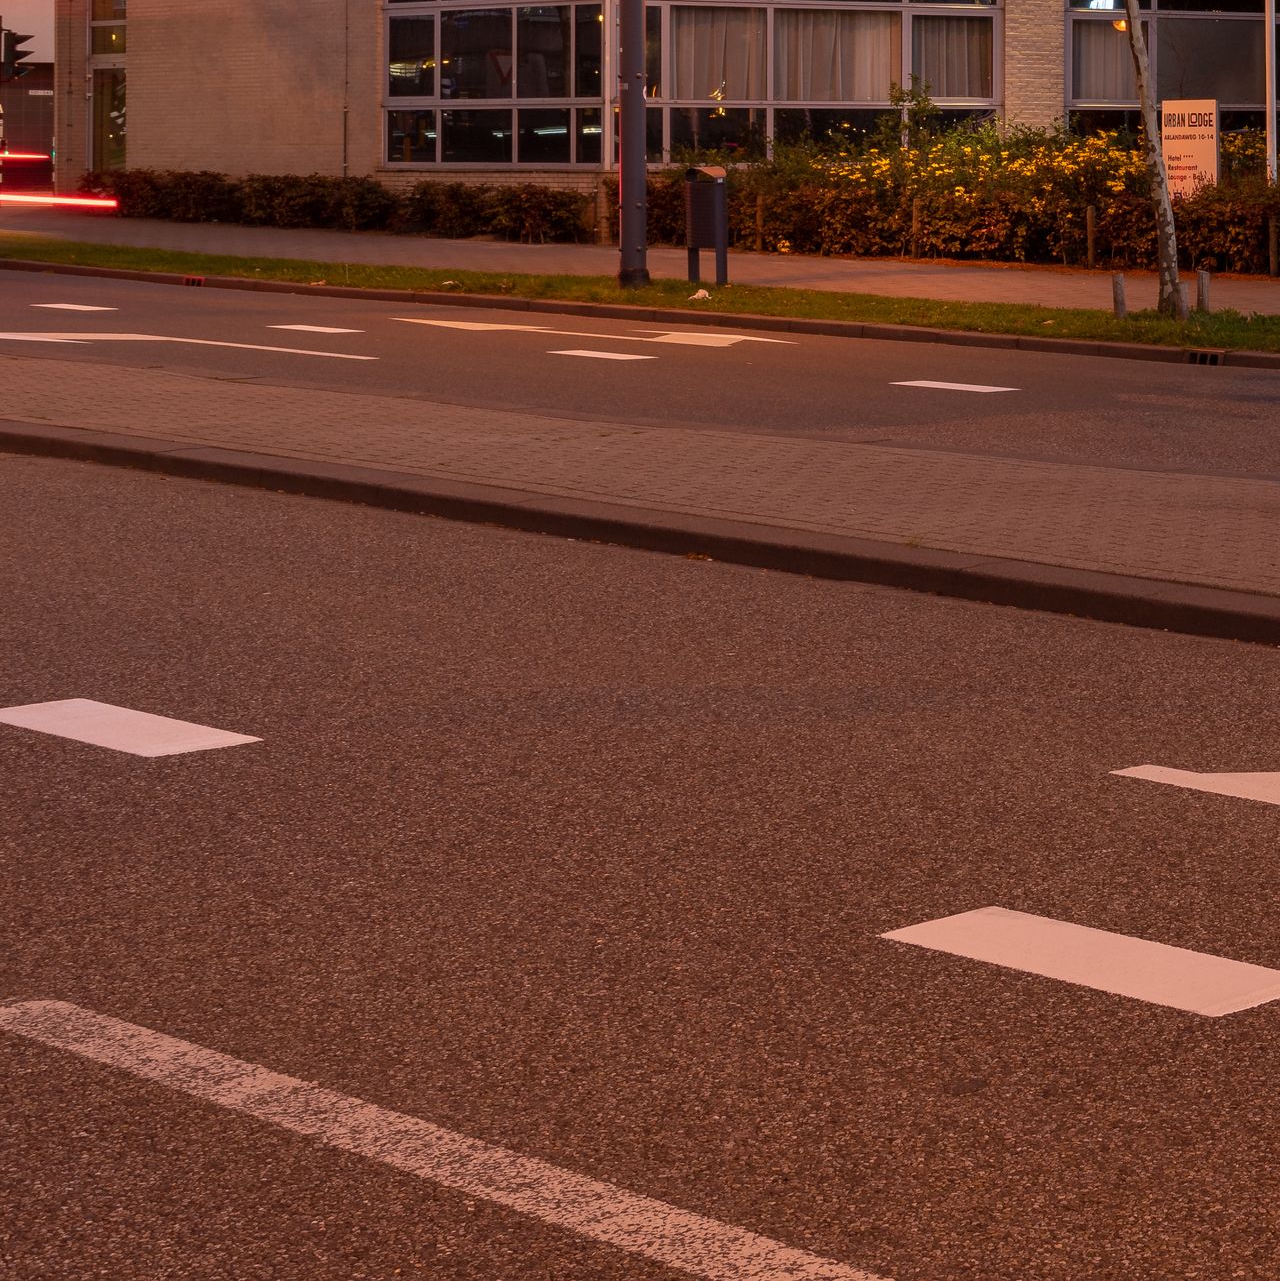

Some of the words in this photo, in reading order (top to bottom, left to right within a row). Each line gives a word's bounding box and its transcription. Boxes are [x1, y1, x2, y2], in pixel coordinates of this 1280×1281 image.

[1164, 112, 1186, 128] URBAN
[1187, 112, 1214, 128] LODGE
[1167, 154, 1182, 162] Hotel
[1167, 173, 1187, 182] Lounge
